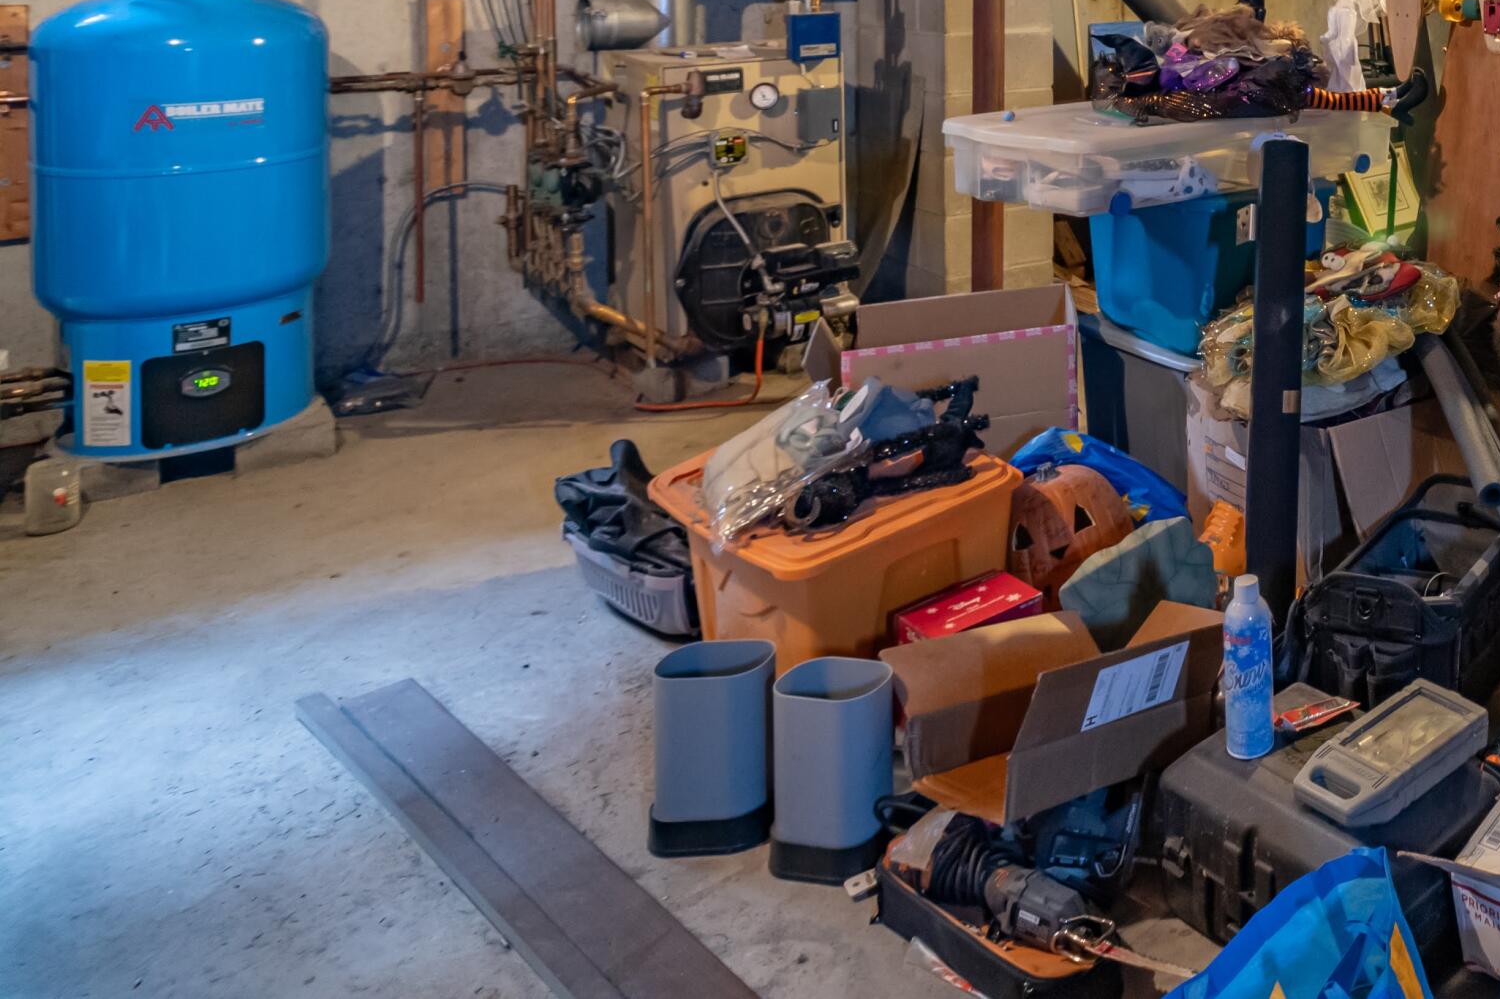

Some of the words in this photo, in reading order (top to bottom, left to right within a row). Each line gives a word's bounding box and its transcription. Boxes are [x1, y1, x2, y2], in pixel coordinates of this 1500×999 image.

[166, 104, 220, 118] BOILER
[223, 100, 264, 114] MATE
[1225, 663, 1266, 690] Snow
